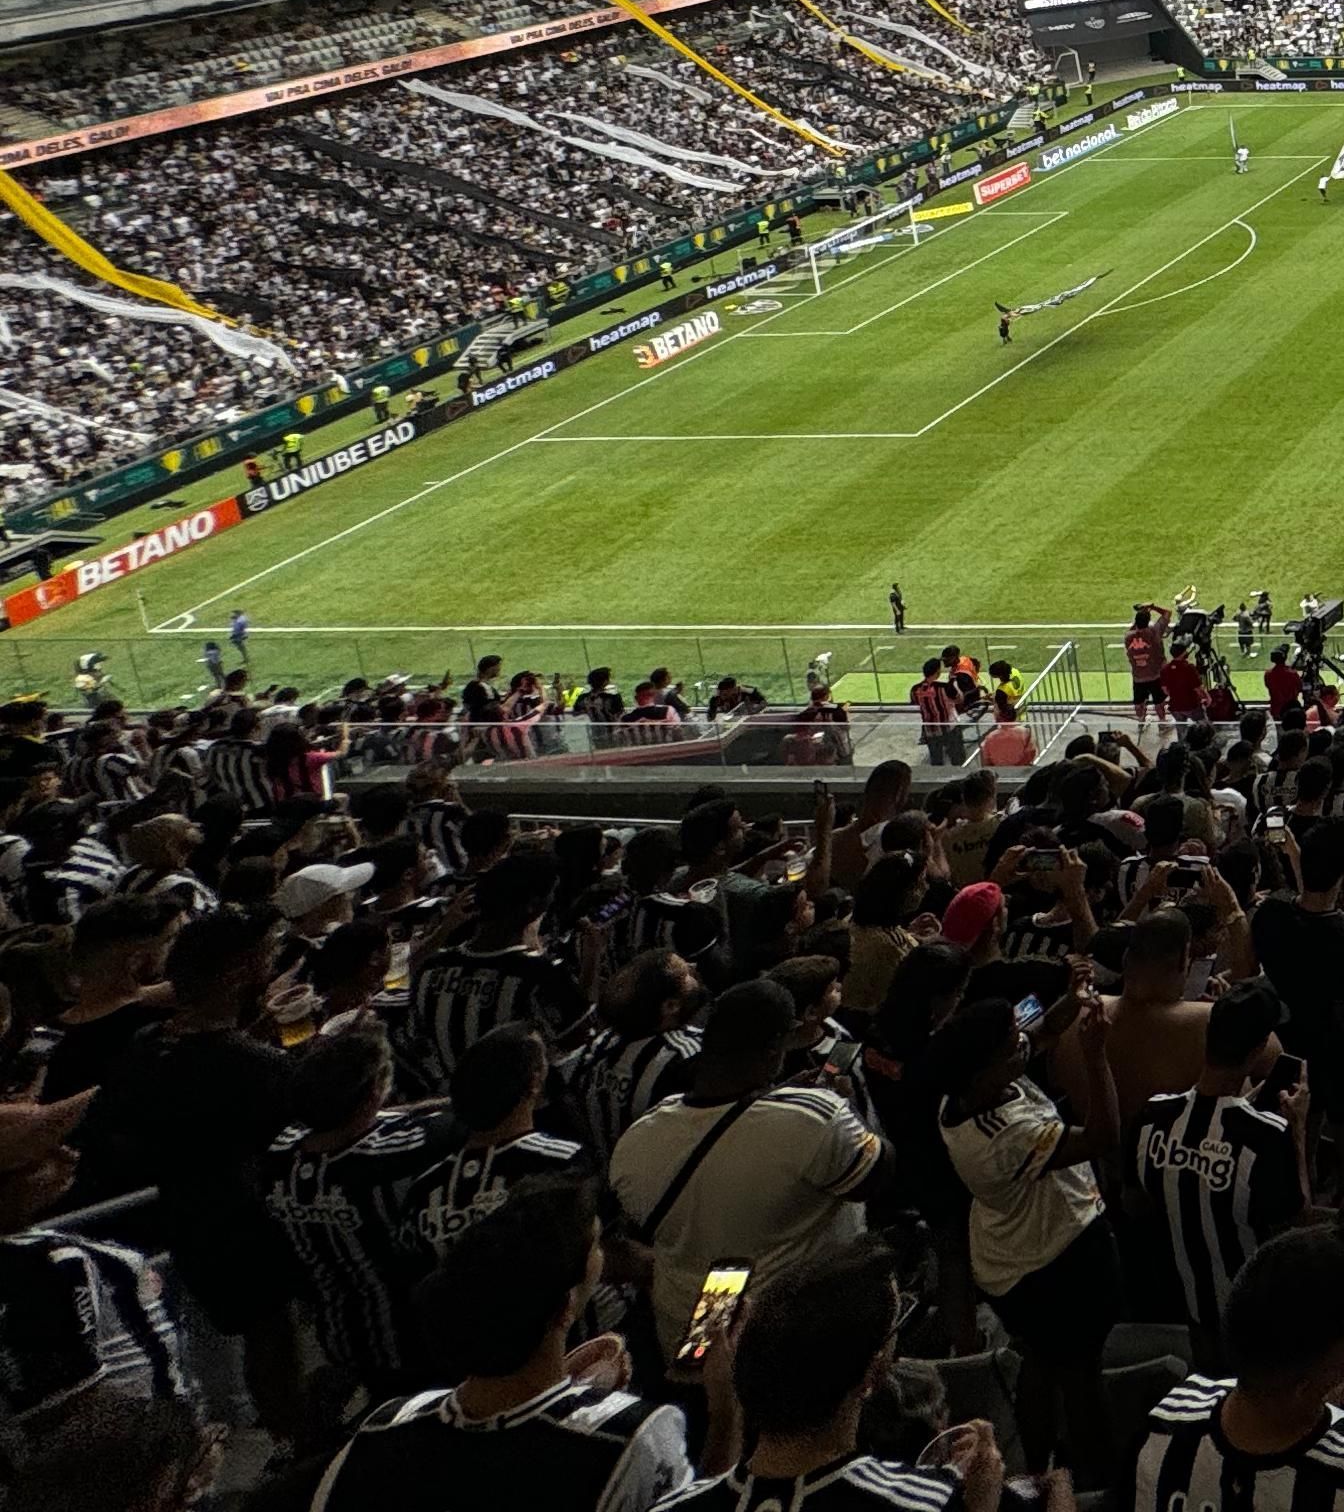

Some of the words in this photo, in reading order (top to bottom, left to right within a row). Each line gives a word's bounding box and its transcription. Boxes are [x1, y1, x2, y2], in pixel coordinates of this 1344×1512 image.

[1171, 80, 1222, 92] heatmap
[1255, 80, 1306, 92] heatmap
[1042, 146, 1065, 169] bet
[1066, 125, 1117, 161] nacional
[939, 164, 982, 189] heatmap
[980, 168, 1029, 199] SUPERBET
[707, 264, 777, 299] heatmap
[590, 310, 661, 352] heatmap
[653, 311, 720, 361] BETANO
[472, 361, 556, 406] heatmap
[270, 444, 368, 501] UNIUBE
[369, 421, 415, 456] EAD
[78, 510, 216, 594] BETANO
[1168, 1138, 1233, 1188] bmg
